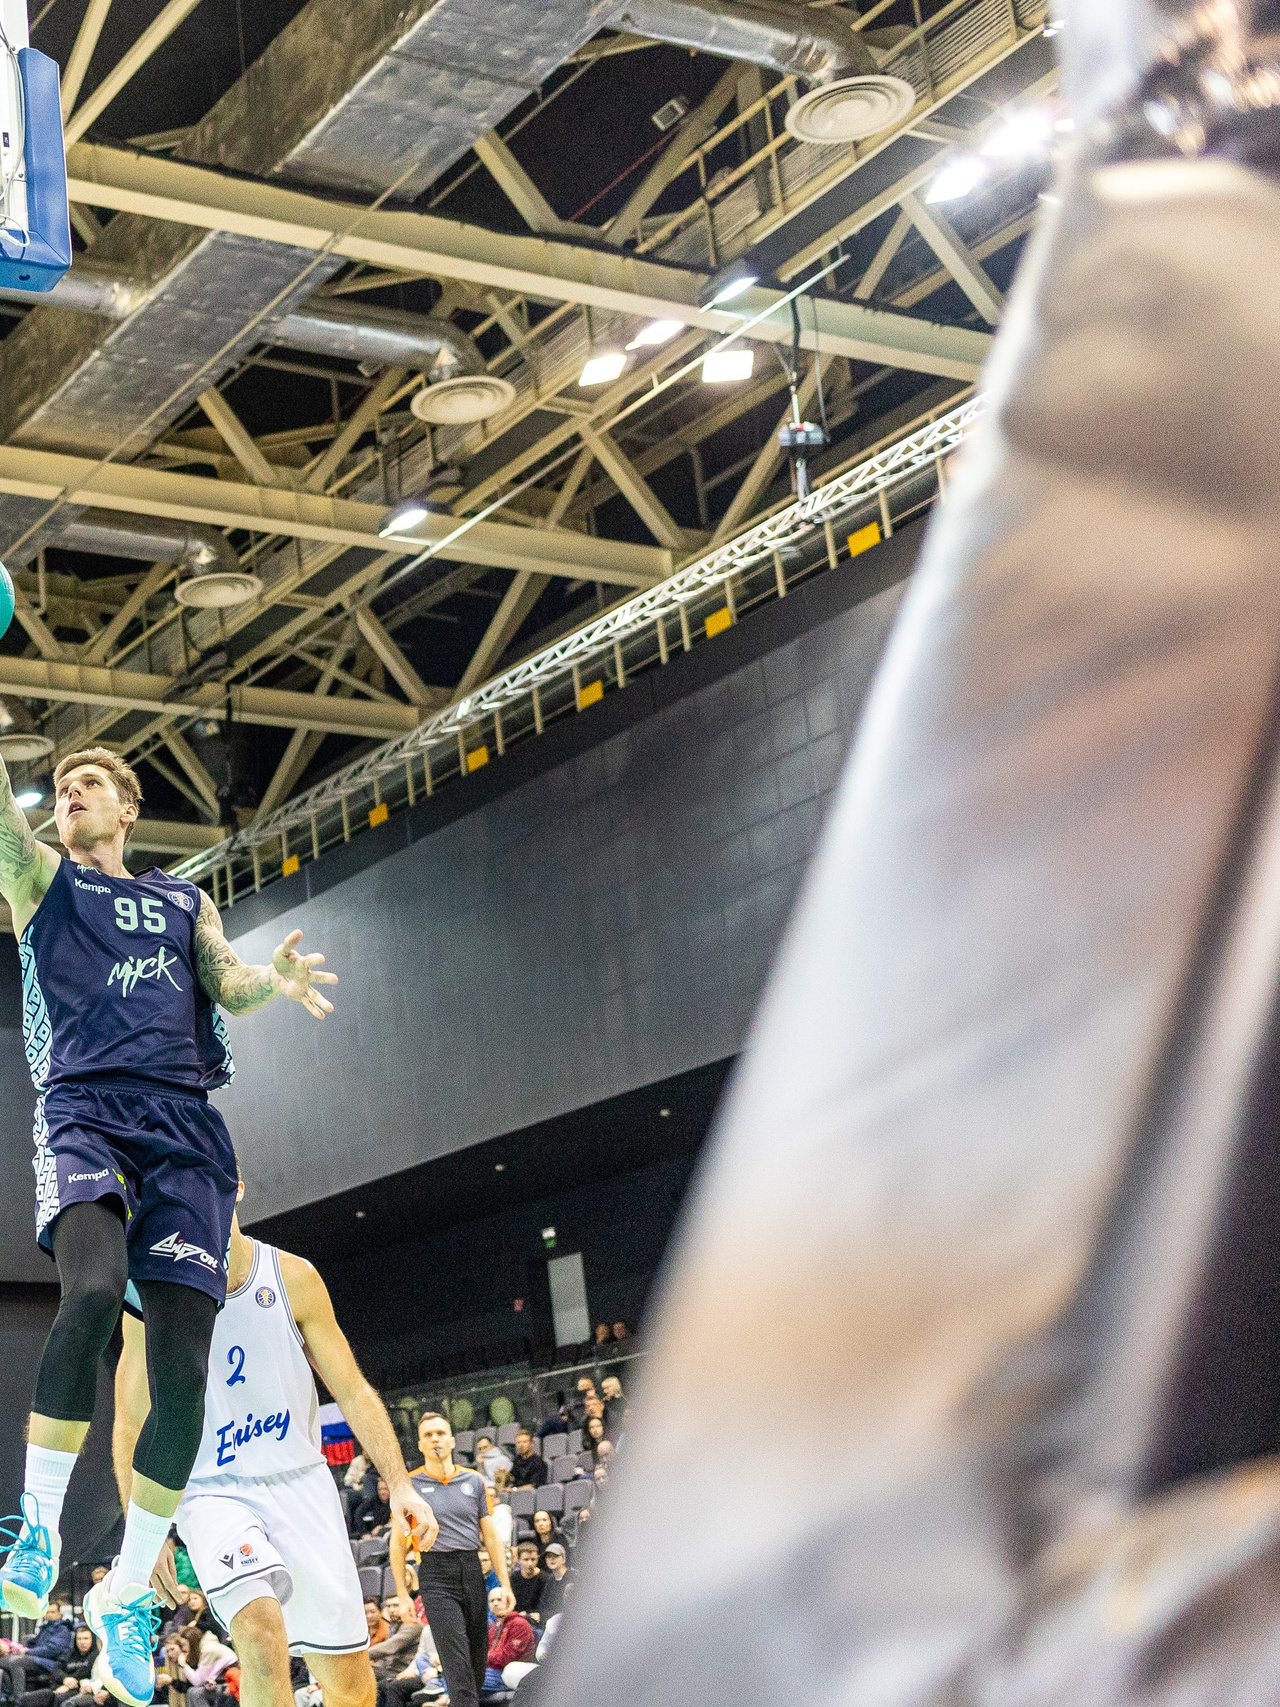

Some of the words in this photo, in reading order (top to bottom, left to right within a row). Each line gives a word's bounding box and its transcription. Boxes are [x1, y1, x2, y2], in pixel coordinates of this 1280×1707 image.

[74, 877, 112, 895] Kempa
[114, 897, 167, 934] 95
[67, 1167, 110, 1184] Kempa
[225, 1345, 246, 1387] 2
[216, 1408, 291, 1467] Enisey
